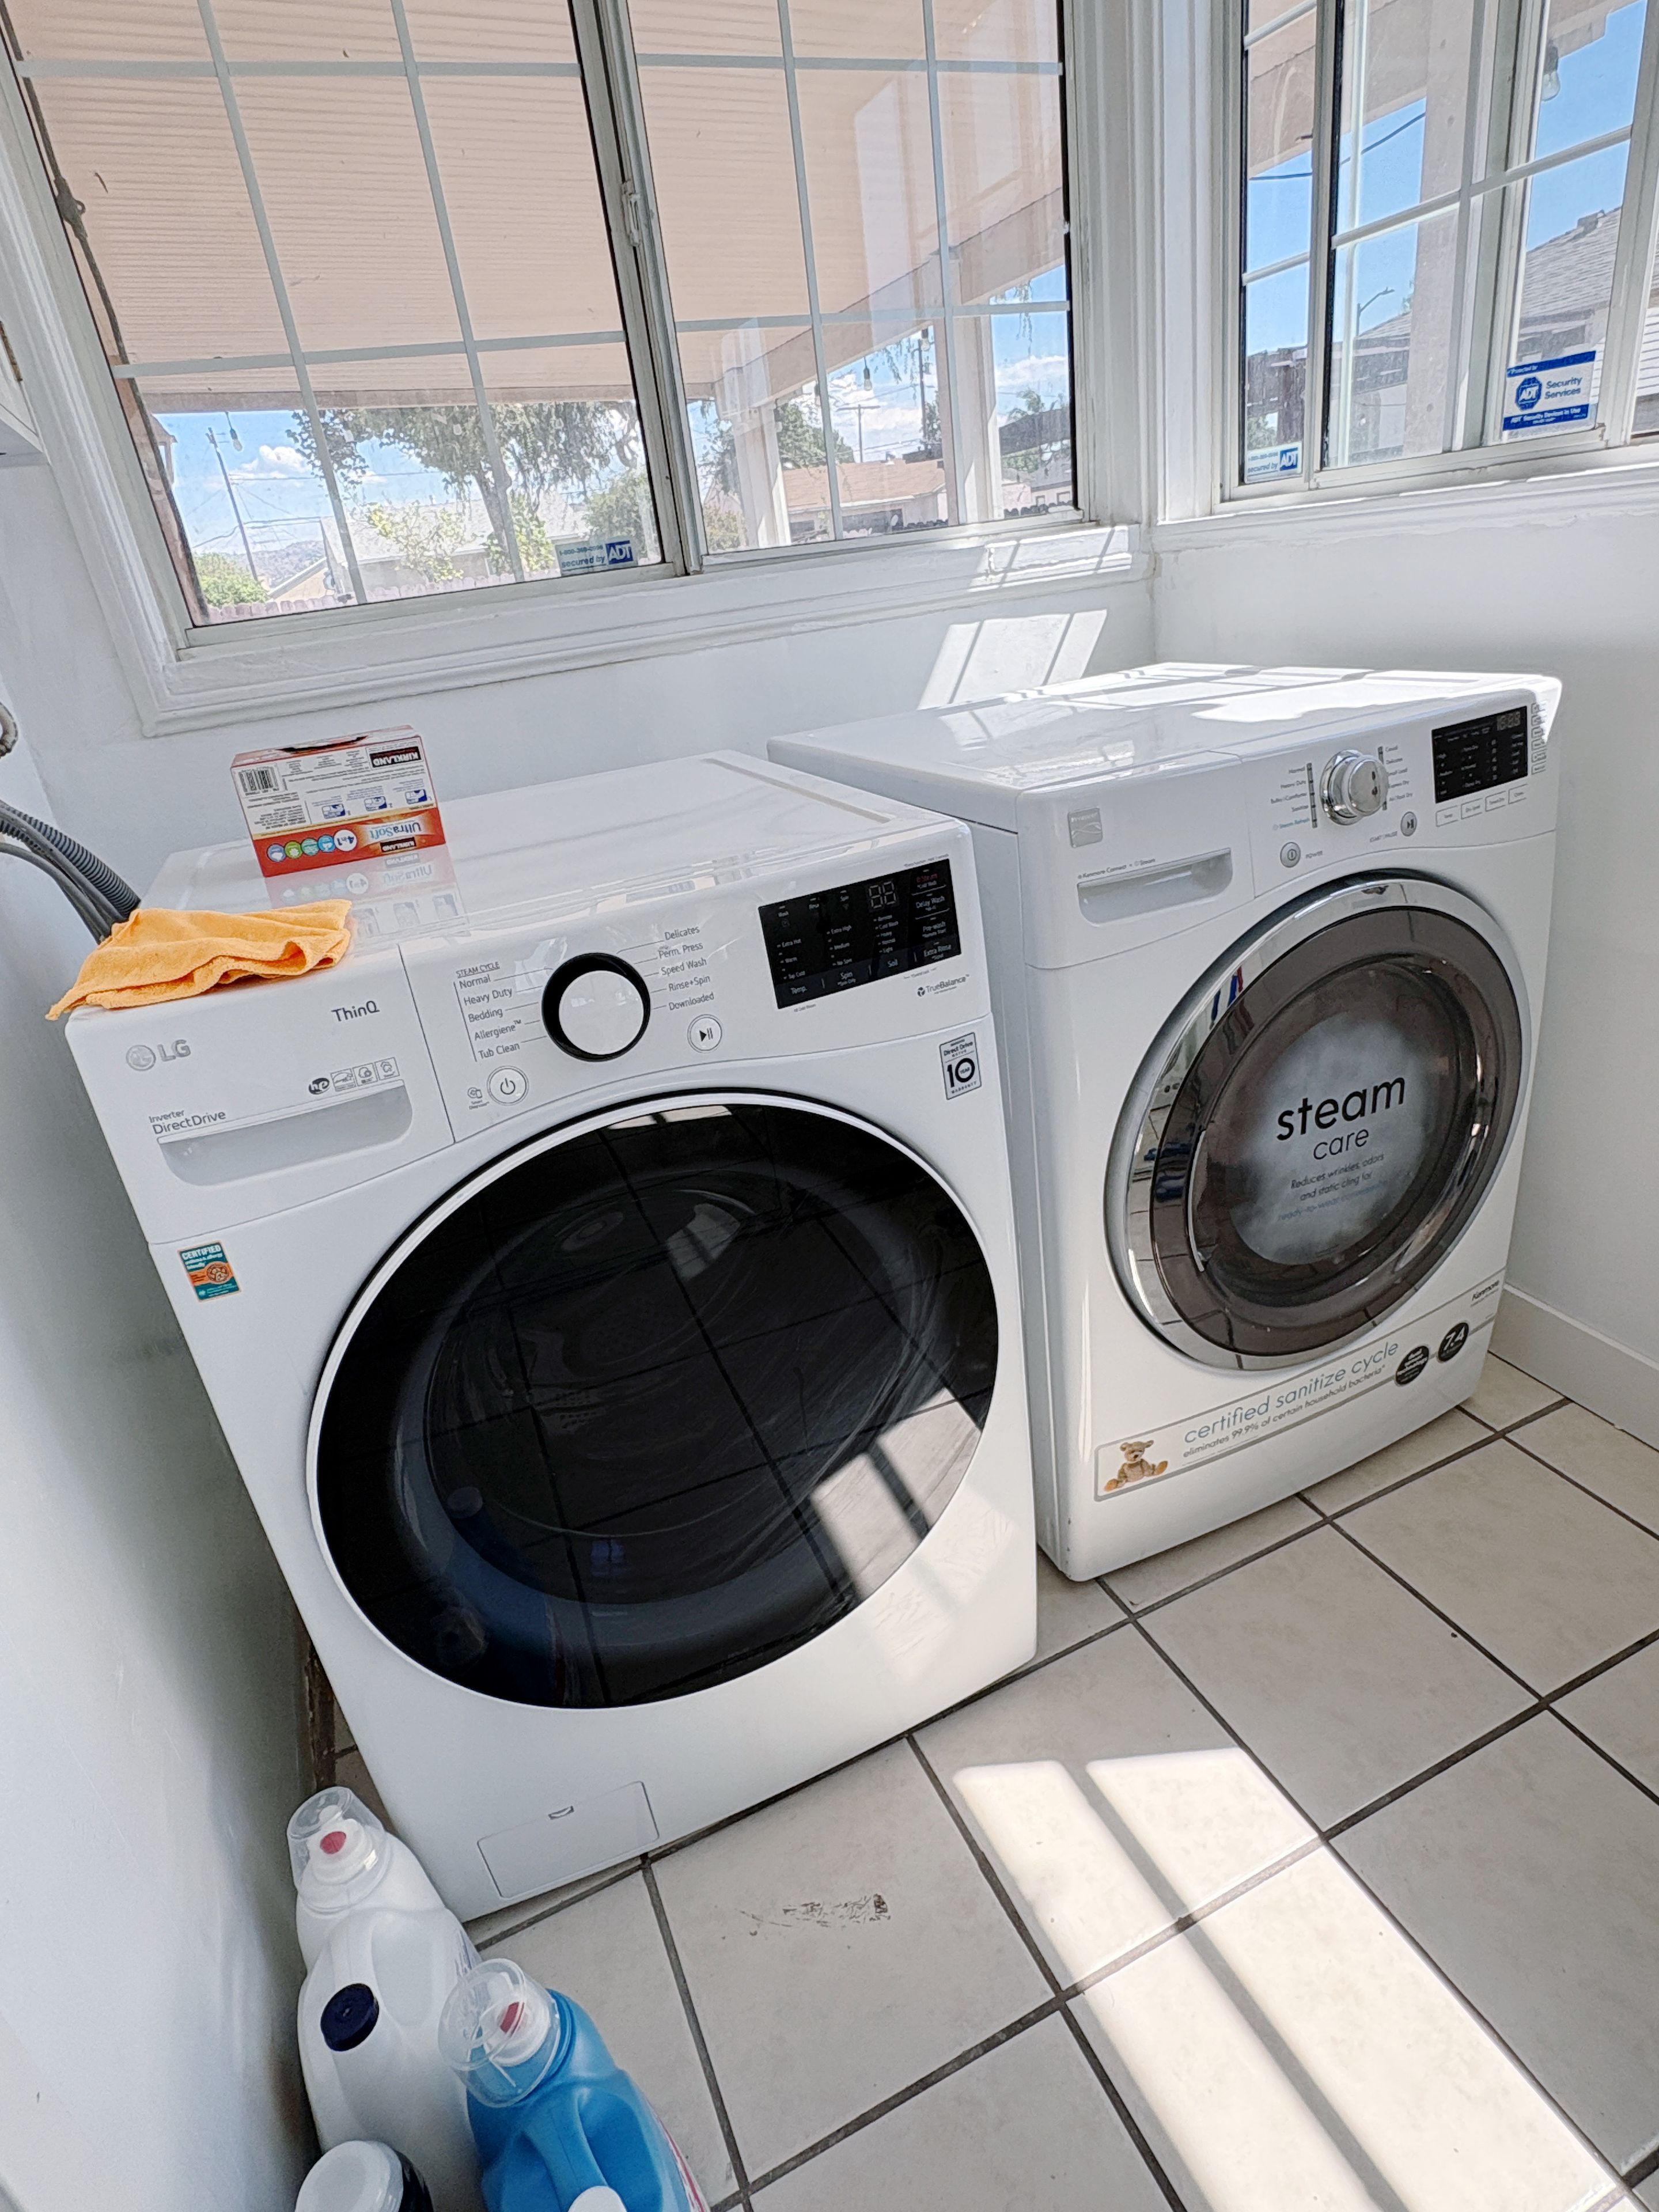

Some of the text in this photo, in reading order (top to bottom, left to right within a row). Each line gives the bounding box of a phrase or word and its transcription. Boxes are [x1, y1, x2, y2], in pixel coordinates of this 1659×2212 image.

[1546, 377, 1582, 389] Security
[1519, 387, 1538, 402] ADT
[1545, 388, 1581, 399] Services
[1280, 452, 1298, 467] ADT
[608, 544, 631, 560] ADT
[562, 556, 605, 568] secured by
[372, 752, 419, 766] KIRKLAND
[370, 822, 422, 839] UltraSoft
[382, 840, 415, 851] KIRKLAND
[664, 926, 700, 941] Delicates
[658, 942, 703, 959] Perm. Press
[456, 961, 500, 978] STEAM CYCLE
[661, 957, 707, 977] Speed Wash
[887, 959, 899, 968] Soil
[459, 974, 491, 989] Normal
[668, 975, 711, 992] Rinse+Spin
[840, 971, 853, 980] Spin
[463, 988, 513, 1006] Heavy Duty
[790, 986, 808, 994] Temp.
[668, 991, 714, 1011] Downloaded
[331, 1000, 380, 1022] ThinQ
[468, 1009, 503, 1022] Bedding
[157, 1039, 191, 1062] LG
[478, 1043, 520, 1059] Tub Clean
[944, 1046, 959, 1056] Direct
[947, 1058, 975, 1088] 10
[149, 1110, 184, 1123] Inverter
[1277, 1077, 1406, 1141] steam
[1313, 1129, 1370, 1160] care
[1290, 1172, 1326, 1190] Reduces
[1362, 1154, 1385, 1167] odors
[1300, 1189, 1317, 1201] and
[1318, 1182, 1340, 1195] static
[1342, 1176, 1360, 1188] cling
[181, 1244, 221, 1260] CERTIFIED
[1472, 1280, 1499, 1301] Kenmore
[1443, 1326, 1465, 1351] 7.4
[1184, 1342, 1399, 1443] certified sanitize cycle
[1183, 1435, 1230, 1458] eliminates
[1232, 1422, 1259, 1439] 99.9%
[1260, 1416, 1271, 1427] of
[1272, 1404, 1303, 1422] certain
[1305, 1383, 1348, 1409] household
